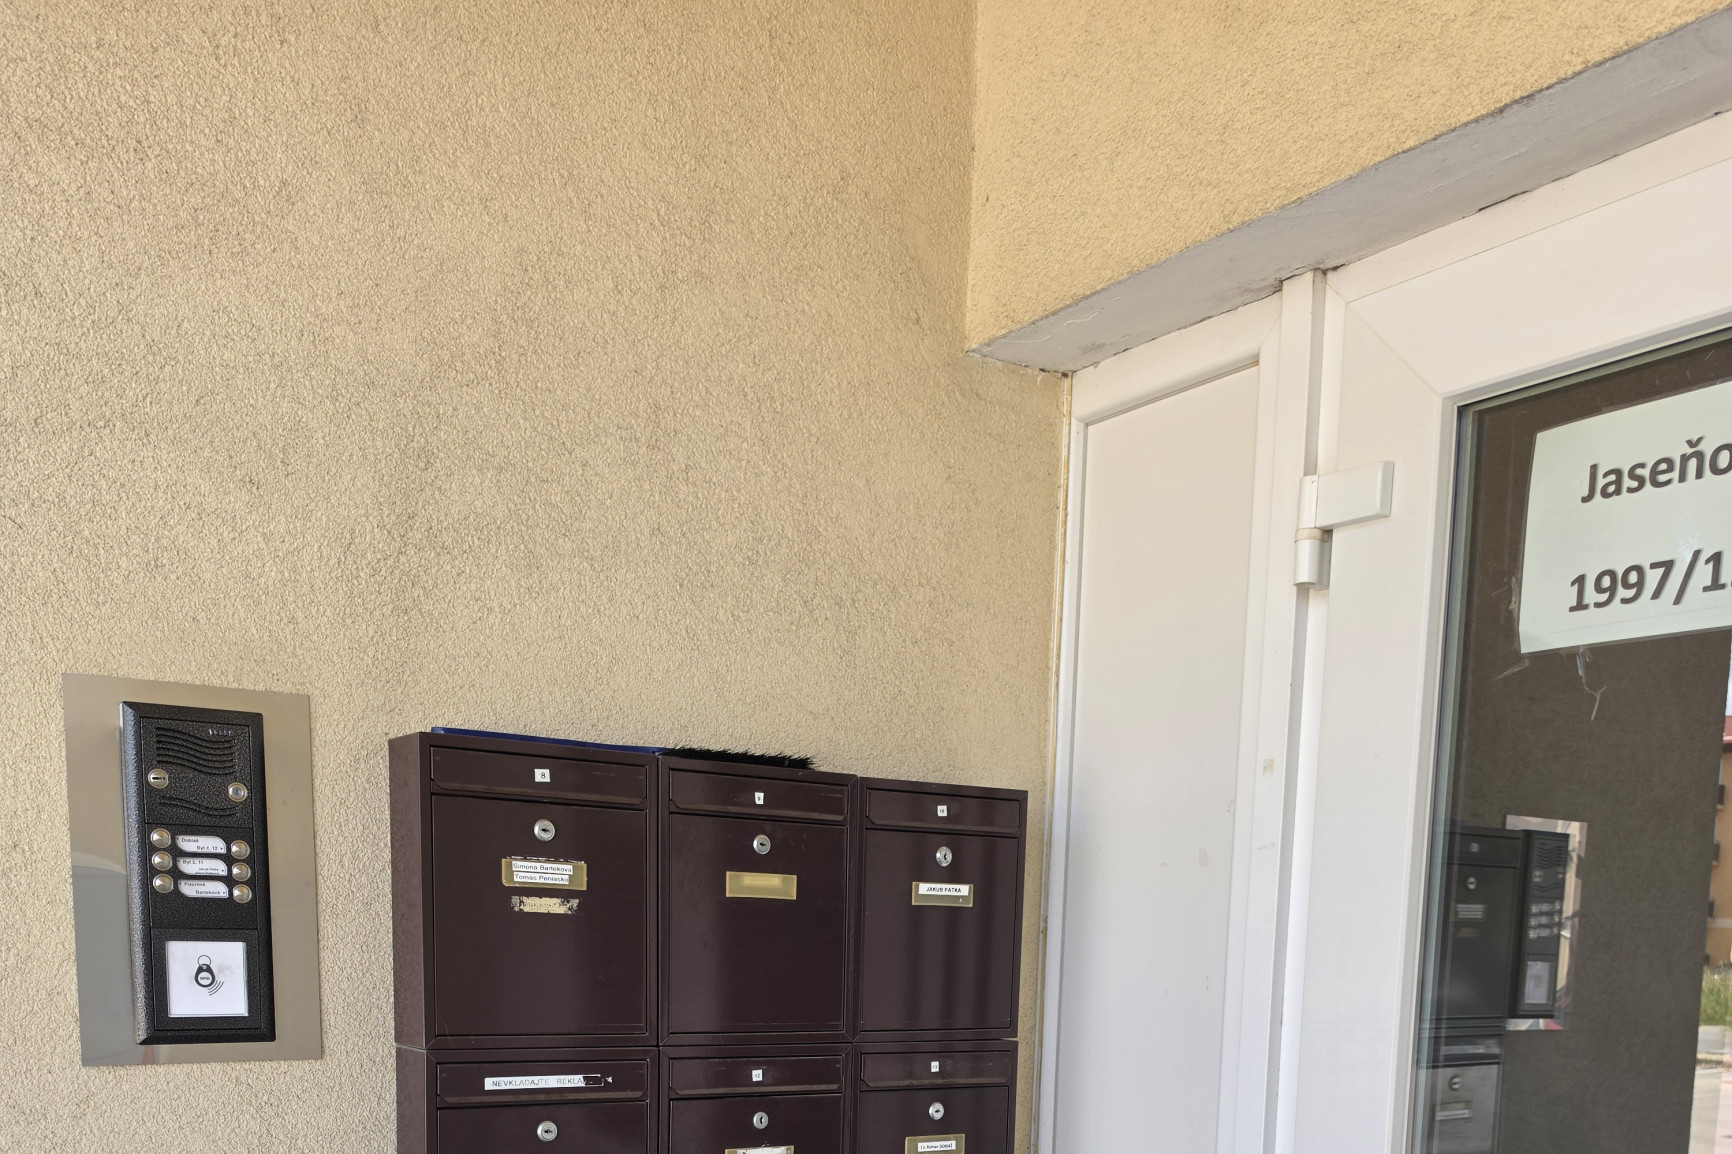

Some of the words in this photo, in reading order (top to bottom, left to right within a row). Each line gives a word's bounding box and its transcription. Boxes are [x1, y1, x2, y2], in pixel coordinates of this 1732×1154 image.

[1580, 436, 1732, 504] Jaseňo
[1568, 548, 1732, 613] 1997/1
[491, 1078, 550, 1088] NEVKLADAJTE
[556, 1077, 587, 1086] REKLA
